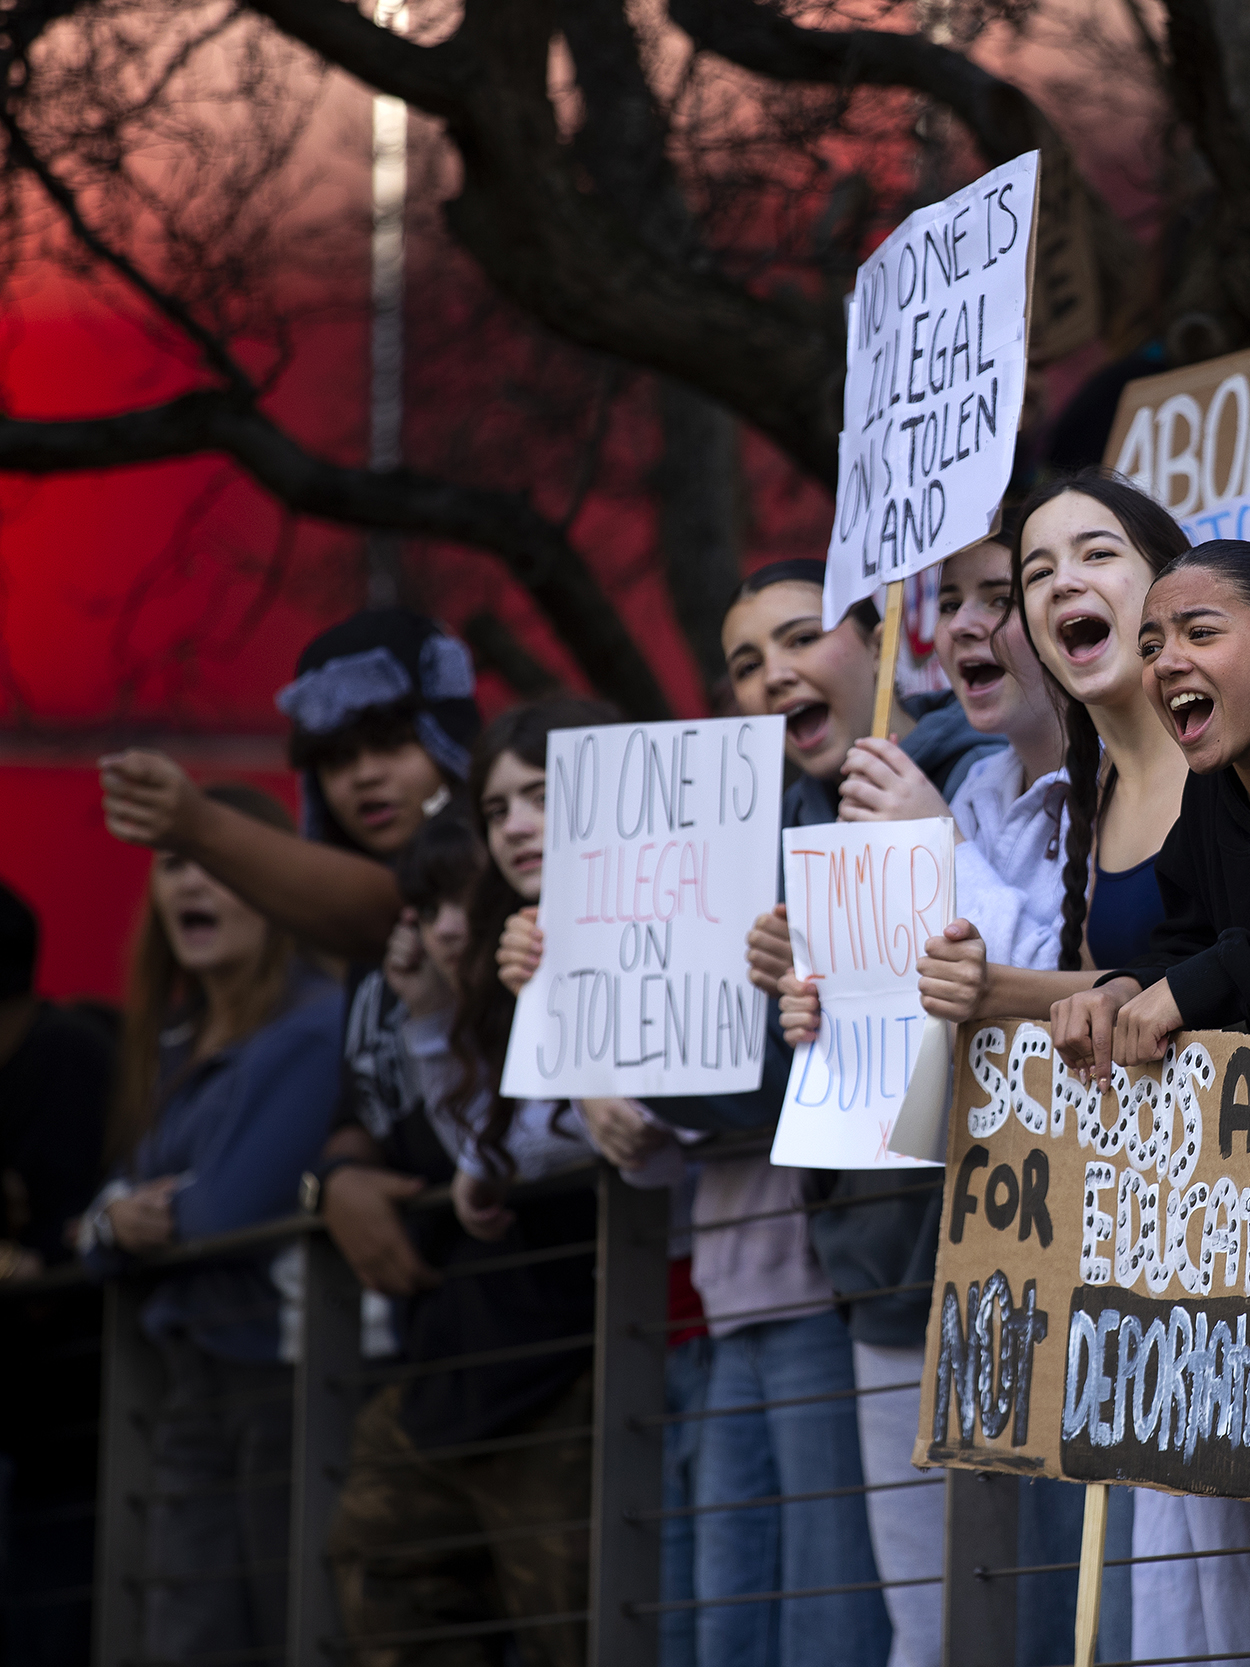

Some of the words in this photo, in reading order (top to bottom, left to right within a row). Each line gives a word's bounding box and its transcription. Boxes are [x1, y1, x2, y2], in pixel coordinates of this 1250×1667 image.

[858, 261, 888, 350] NO
[899, 207, 971, 311] ONE
[982, 183, 1018, 270] IS
[861, 294, 994, 435] ILLEGAL
[840, 437, 875, 544] ON
[881, 376, 998, 499] STOLEN
[862, 479, 946, 579] LAND
[552, 733, 599, 851] NO
[616, 728, 699, 841] ONE
[719, 723, 758, 826] IS
[575, 840, 721, 926] ILLEGAL
[619, 920, 673, 972] ON
[536, 968, 691, 1080] STOLEN
[795, 1006, 918, 1112] BUILT
[948, 1144, 1054, 1248] FOR
